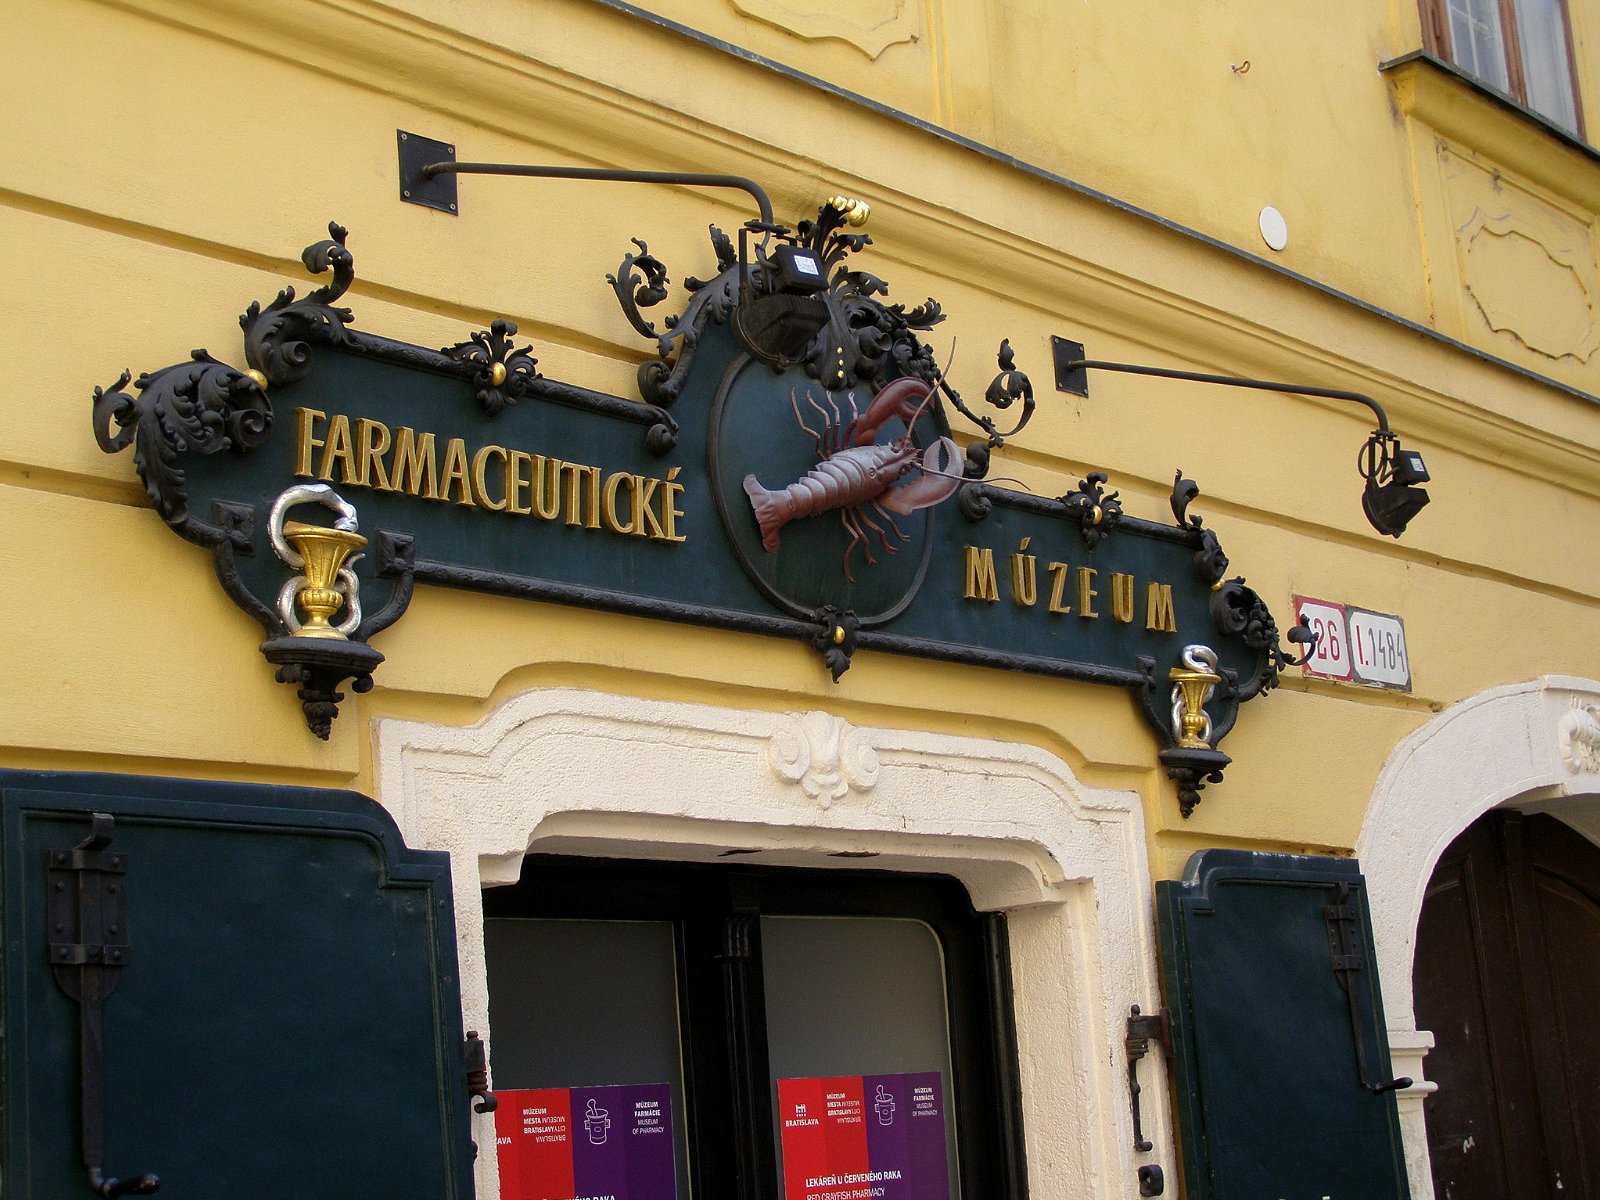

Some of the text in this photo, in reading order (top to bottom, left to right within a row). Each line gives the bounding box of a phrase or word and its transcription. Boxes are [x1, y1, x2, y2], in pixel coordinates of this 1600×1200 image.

[294, 407, 1178, 633] FARMACEUTICKÉ MÚZEUM
[1313, 617, 1340, 662] 26
[635, 1101, 659, 1109] MÚZEUM
[523, 1107, 547, 1115] MÚZEUM
[634, 1109, 661, 1117] FARMÁCIE
[523, 1117, 542, 1125] MESTA
[637, 1118, 659, 1126] MUSEUM
[785, 1118, 819, 1127] BRATISLAVA
[523, 1126, 554, 1134] BRATISLAVY
[805, 1170, 902, 1188] LEKÁREŇ U ČERVENÉHO RAKA
[852, 1187, 886, 1199] PHARMACY
